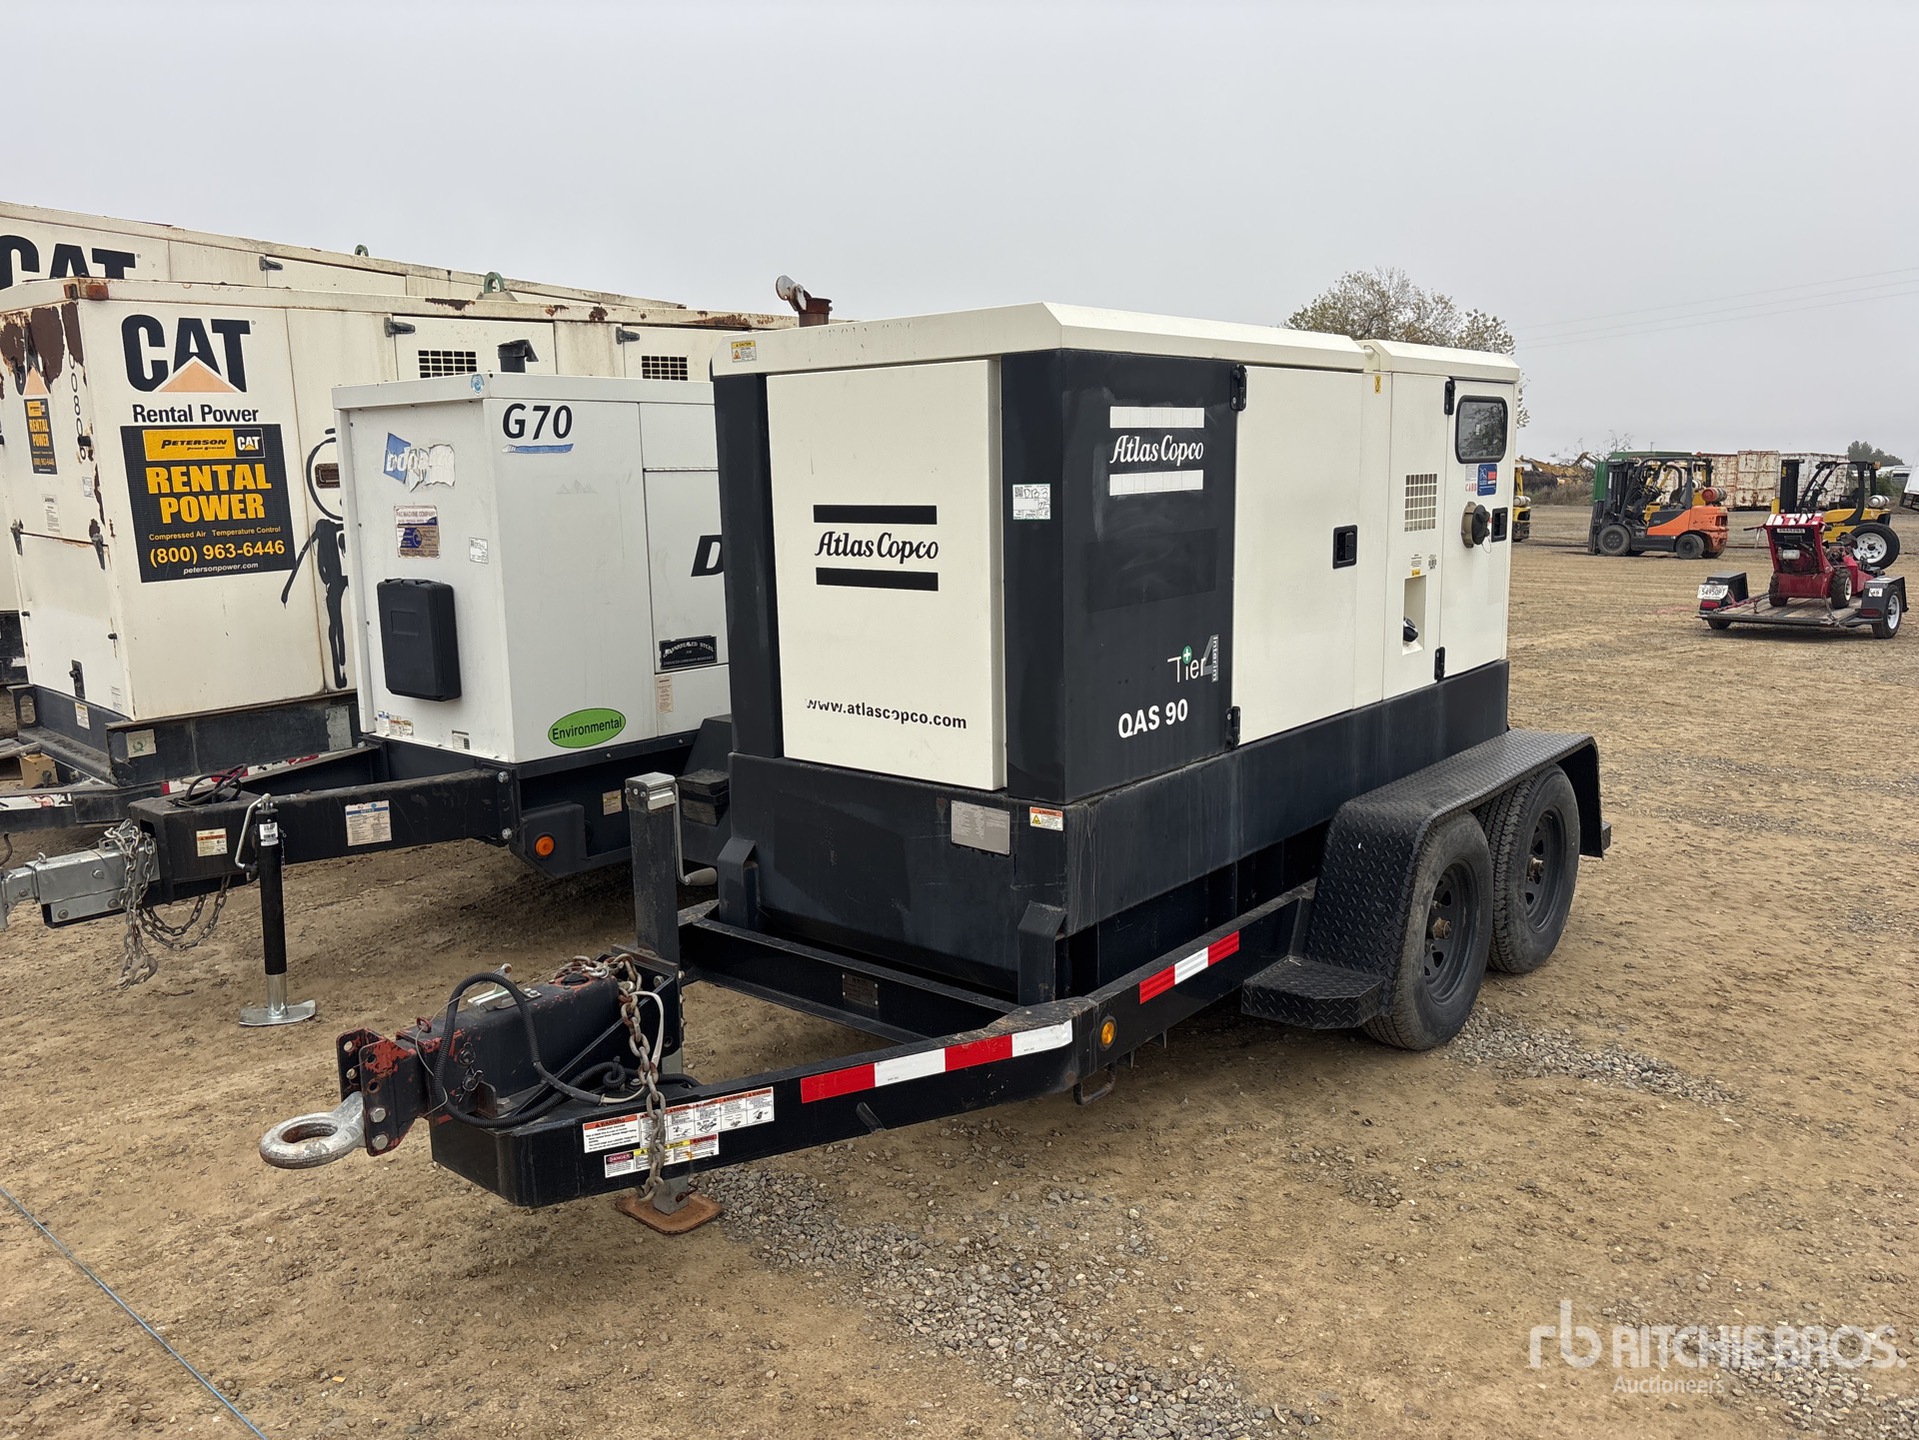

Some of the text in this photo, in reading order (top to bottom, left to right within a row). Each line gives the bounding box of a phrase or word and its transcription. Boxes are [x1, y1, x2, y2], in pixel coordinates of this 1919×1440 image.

[121, 315, 251, 393] CAT
[28, 418, 49, 432] RENTAL
[132, 404, 260, 423] Rental Power
[502, 403, 574, 441] G70
[32, 434, 50, 447] POWER
[161, 436, 261, 451] PETERSON CAT
[1109, 434, 1205, 466] Atlas Copco
[145, 463, 272, 495] RENTAL
[159, 493, 265, 524] POWER
[149, 525, 281, 541] Compressed Air Temperature Control
[814, 530, 939, 564] Atlas Copco
[150, 539, 285, 568] (800) 963-6446
[183, 561, 259, 575] petersonpower.com
[1167, 654, 1206, 683] Tier
[1211, 636, 1219, 681] Interim
[551, 714, 623, 741] Environmental
[805, 698, 967, 730] www.atlascopco.com
[1117, 698, 1189, 740] QAS 90
